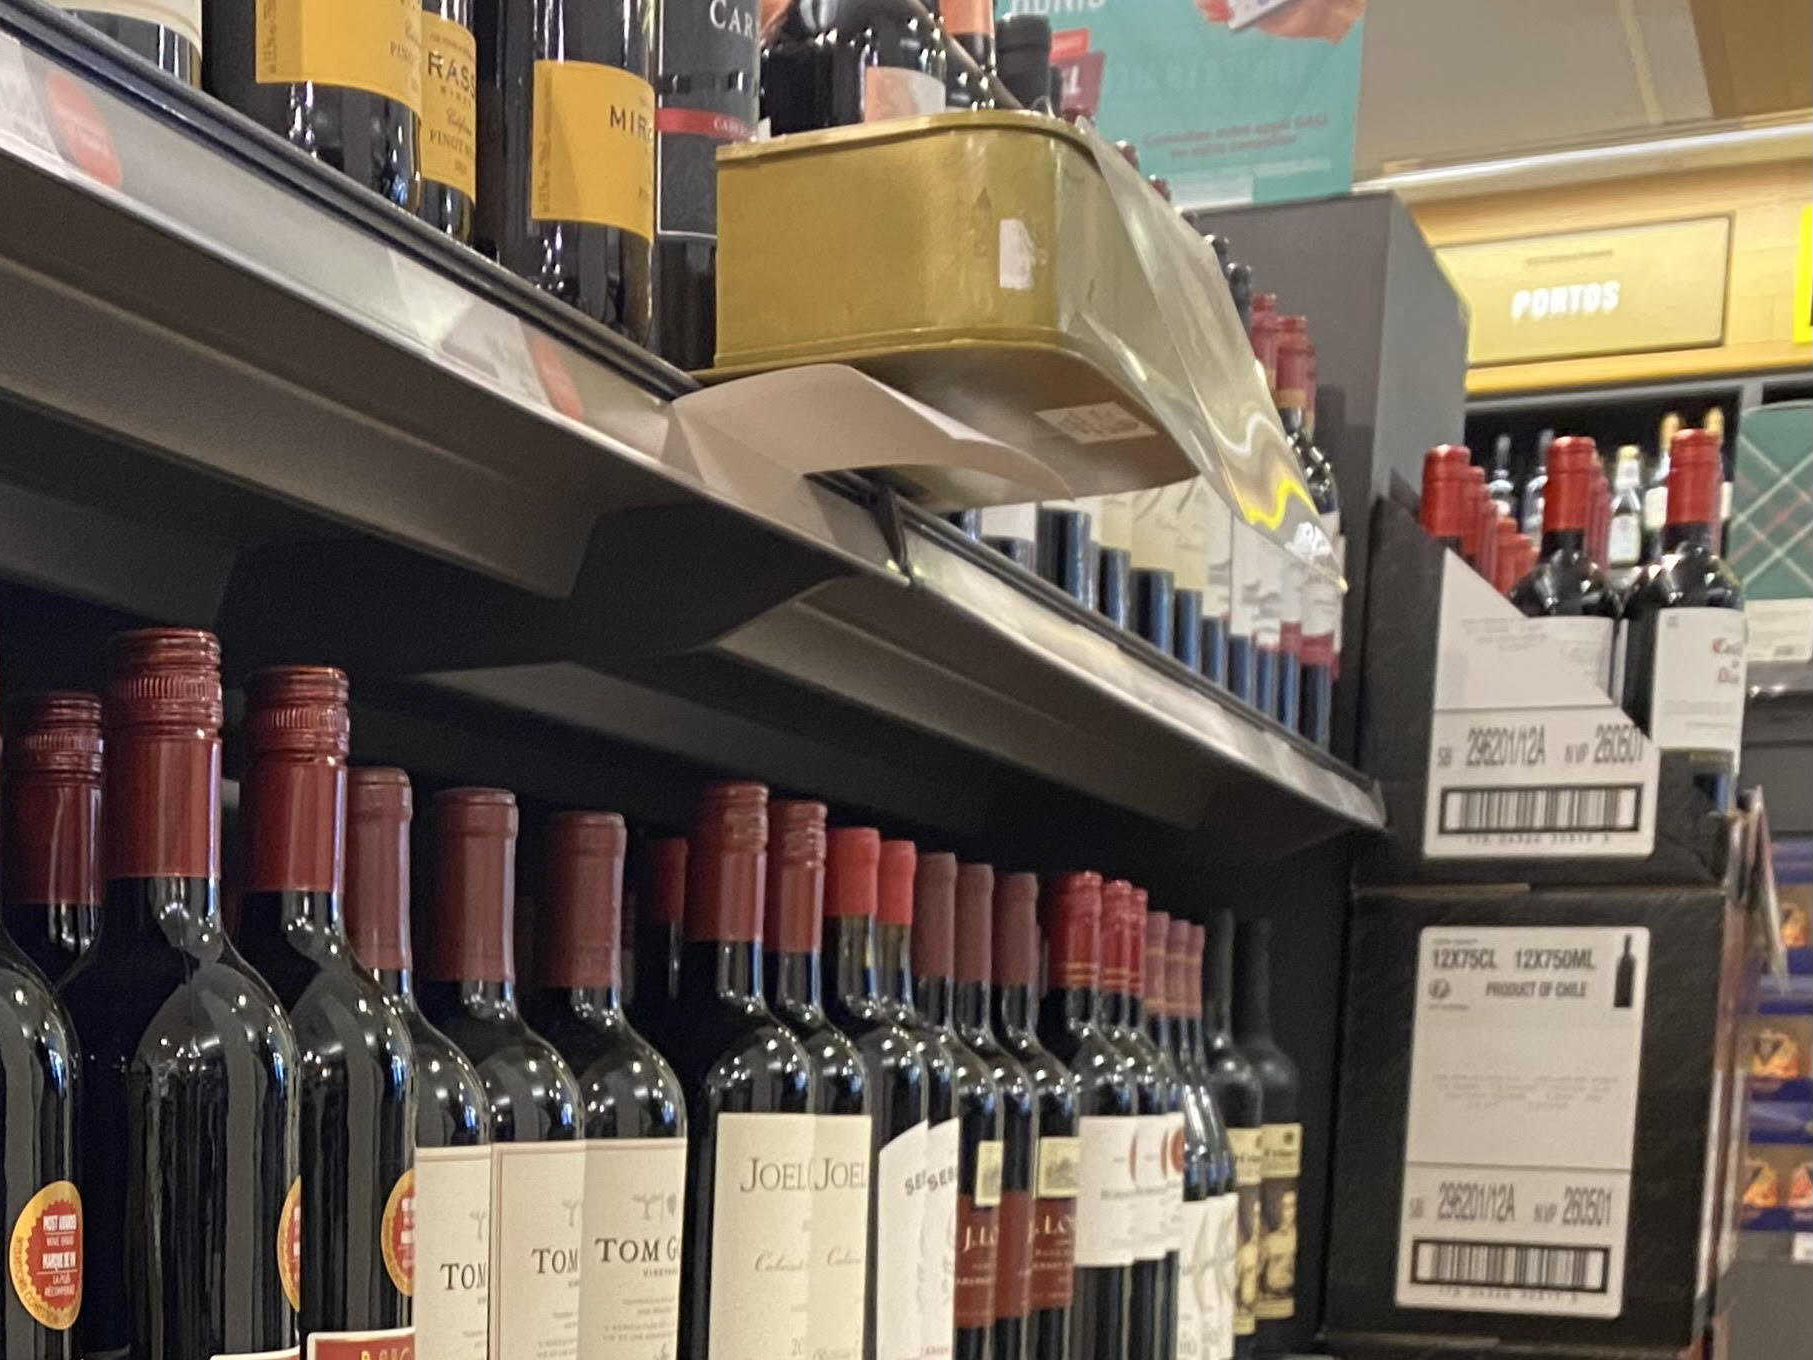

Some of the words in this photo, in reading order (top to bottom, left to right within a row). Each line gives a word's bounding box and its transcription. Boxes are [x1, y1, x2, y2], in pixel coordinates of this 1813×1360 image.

[1511, 280, 1621, 323] PORTOS
[1432, 948, 1497, 971] 12X75CL
[1514, 948, 1596, 971] 12X750ML
[1485, 981, 1537, 999] PRODUCT
[1538, 982, 1554, 998] OF
[1555, 982, 1588, 999] CHILE
[740, 1157, 806, 1193] JOEL
[594, 1236, 660, 1263] TOM
